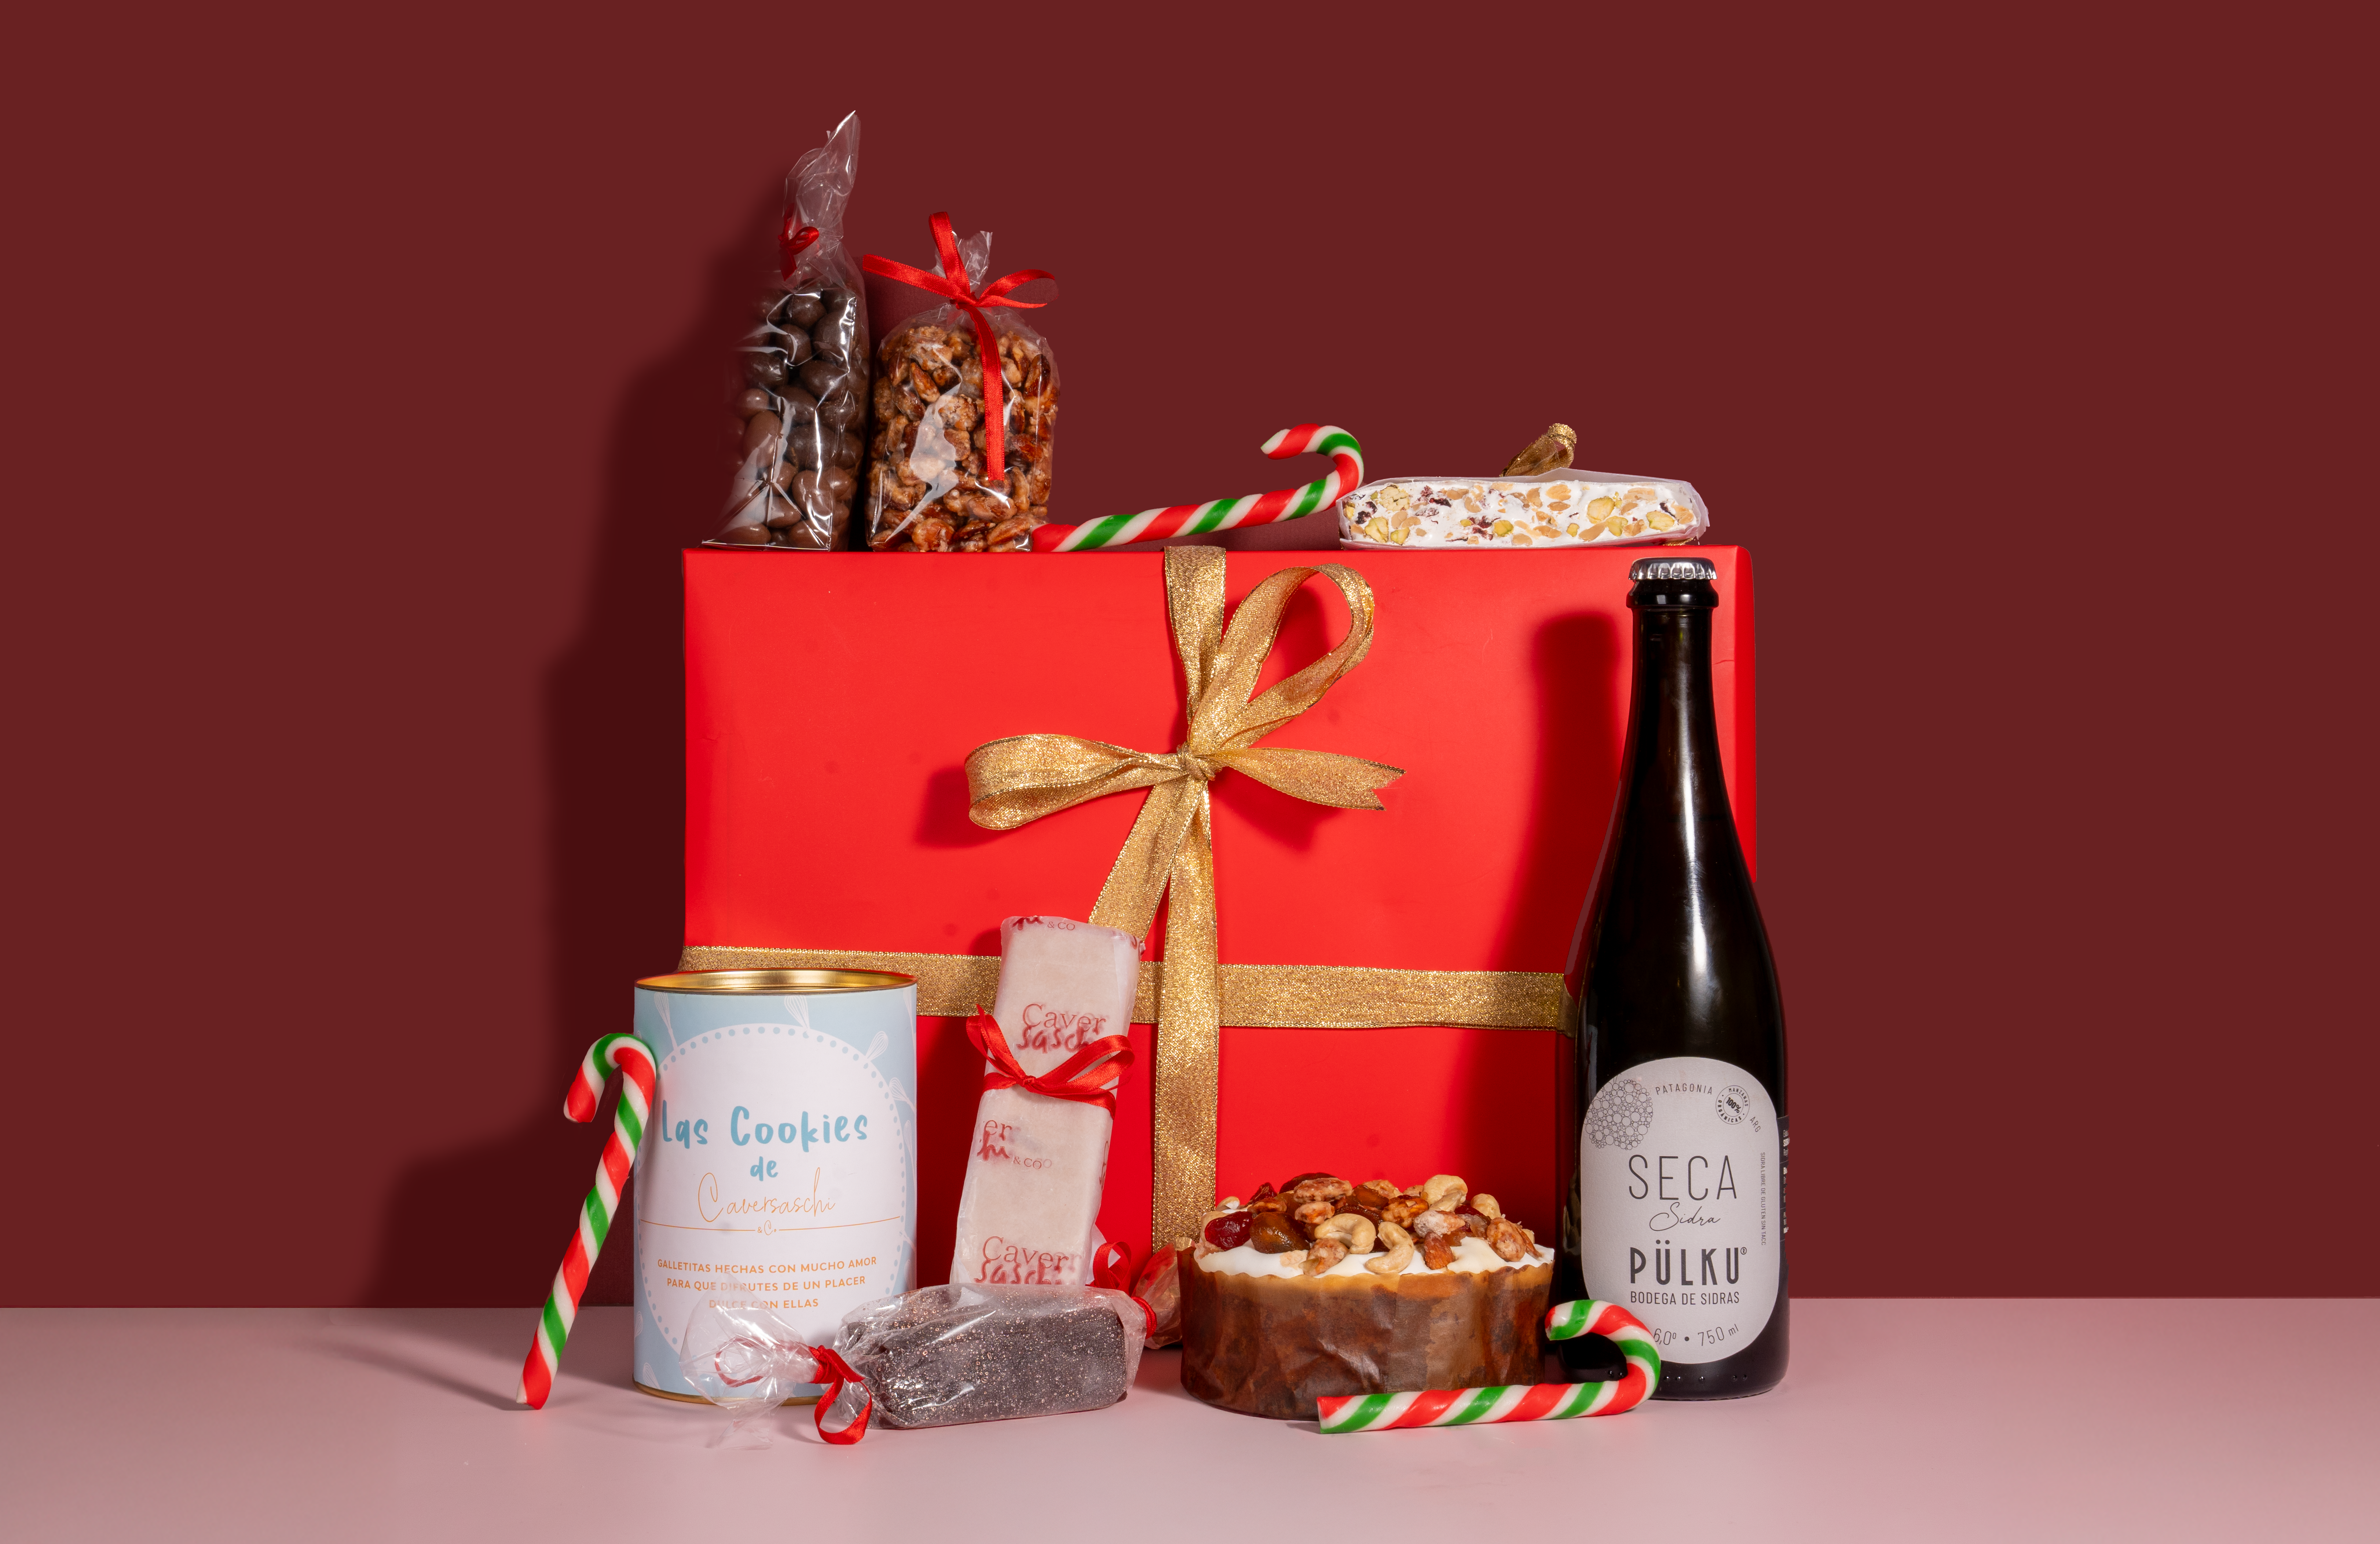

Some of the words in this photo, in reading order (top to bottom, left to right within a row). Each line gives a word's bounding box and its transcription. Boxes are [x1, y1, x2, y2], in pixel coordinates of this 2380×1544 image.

[1058, 922, 1075, 931] CO
[1022, 1003, 1107, 1032] Caver
[1655, 1083, 1712, 1095] PATAGONIA
[1729, 1088, 1749, 1107] MANZANAS
[1718, 1099, 1742, 1123] ORGÁNICAS
[1725, 1097, 1741, 1113] 100%
[731, 1106, 868, 1152] Cookies
[1750, 1116, 1761, 1132] ARG
[750, 1156, 778, 1182] de
[1629, 1154, 1737, 1201] SECA
[698, 1167, 836, 1222] Caversaschi
[1649, 1202, 1721, 1231] Sidra
[982, 1236, 1069, 1270] Caver
[658, 1259, 711, 1272] GALLETITAS
[715, 1264, 764, 1273] HECHAS
[769, 1264, 796, 1273] CON
[801, 1261, 845, 1272] MUCHO
[848, 1256, 876, 1268] AMOR
[667, 1278, 691, 1289] PARA
[694, 1281, 717, 1291] QUE
[783, 1282, 798, 1291] DE
[803, 1281, 820, 1289] UN
[825, 1276, 865, 1288] PLACER
[709, 1300, 747, 1309] DULCE
[751, 1300, 778, 1309] CON
[784, 1299, 819, 1308] ELLAS
[1630, 1291, 1677, 1305] BODEGA
[1682, 1293, 1696, 1305] DE
[1701, 1291, 1740, 1305] SIDRAS
[1698, 1326, 1724, 1346] 750
[1728, 1324, 1739, 1336] ml
